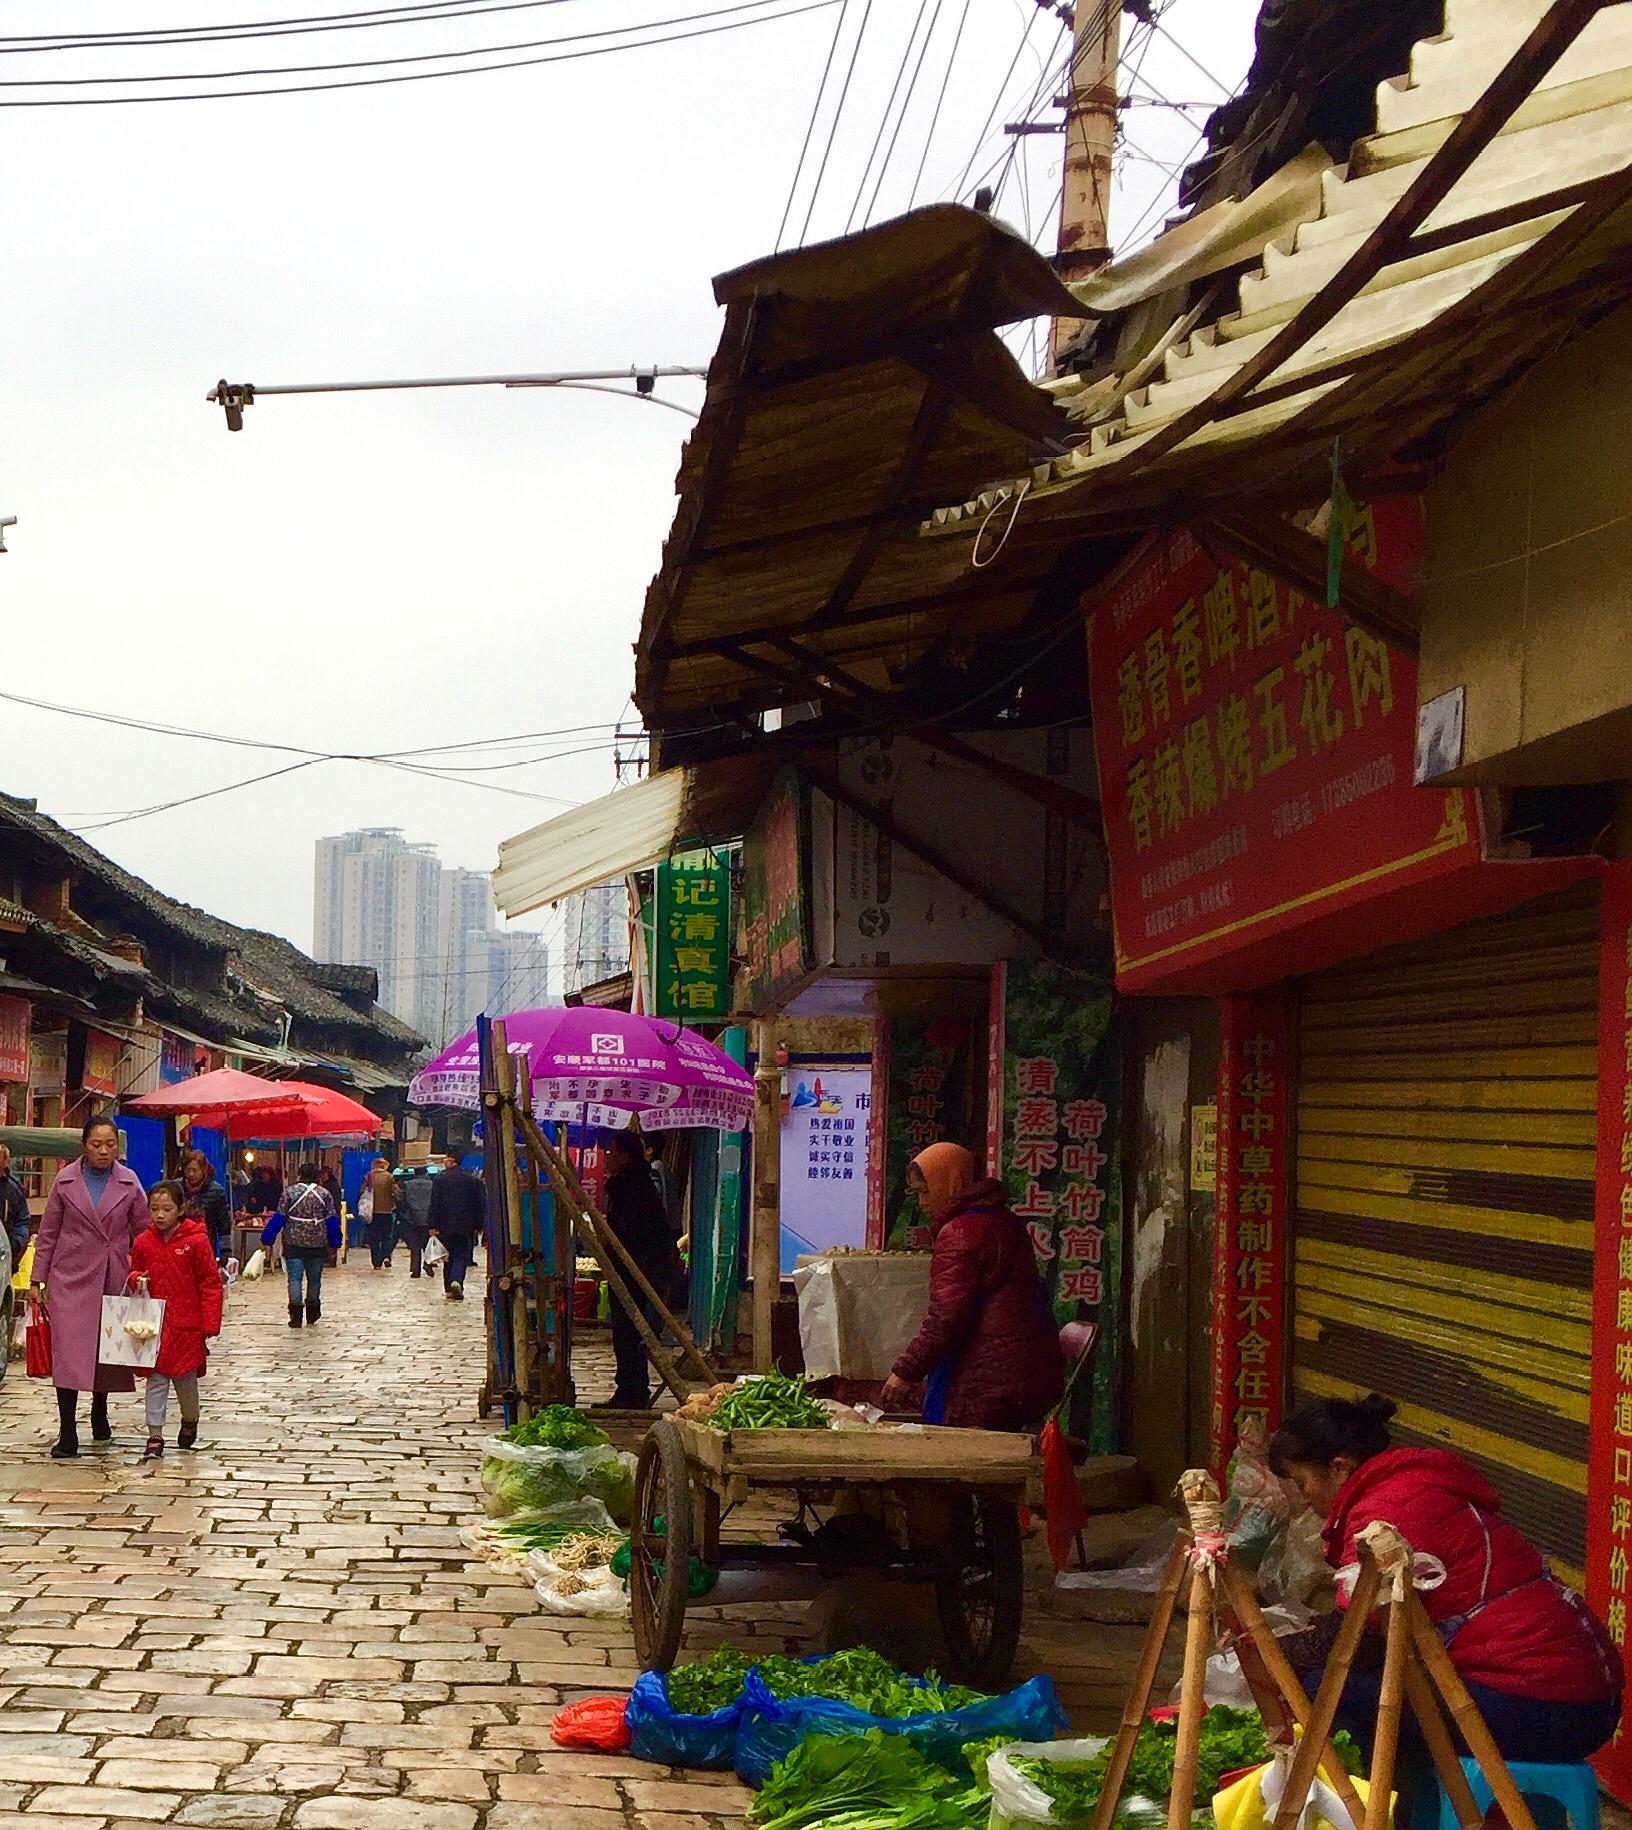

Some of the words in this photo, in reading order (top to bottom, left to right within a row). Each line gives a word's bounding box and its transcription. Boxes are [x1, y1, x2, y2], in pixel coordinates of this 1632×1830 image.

[906, 1065, 945, 1157] 荷叶竹
[809, 1118, 855, 1131] 热爱祖国
[809, 1135, 855, 1147] 实干敬业
[809, 1151, 854, 1163] 诚实守信
[1011, 1057, 1058, 1260] 清蒸不上火
[808, 1167, 853, 1180] 睦邻友善
[1060, 1099, 1107, 1305] 荷叶竹筒鸡
